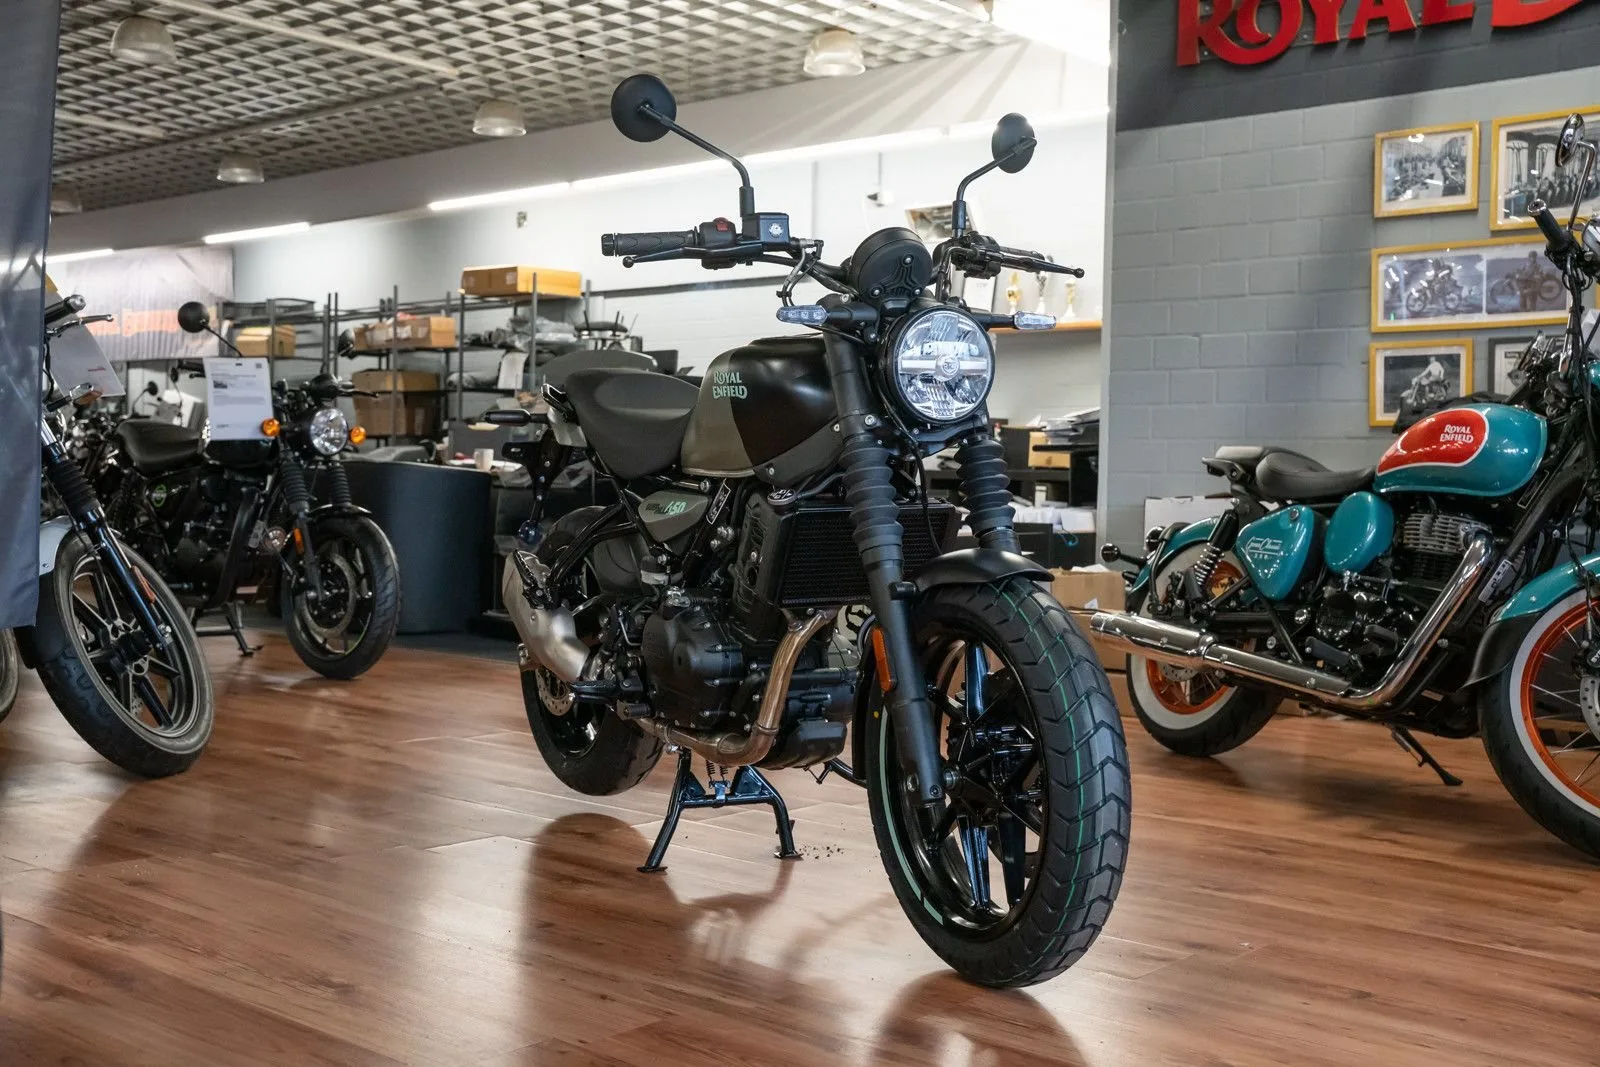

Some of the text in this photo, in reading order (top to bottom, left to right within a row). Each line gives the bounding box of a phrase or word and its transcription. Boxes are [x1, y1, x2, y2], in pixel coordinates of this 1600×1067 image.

[713, 370, 742, 385] ROYAL
[712, 385, 748, 399] ENFIELD
[1444, 424, 1471, 434] ROYAL
[1440, 433, 1474, 443] ENFIELD
